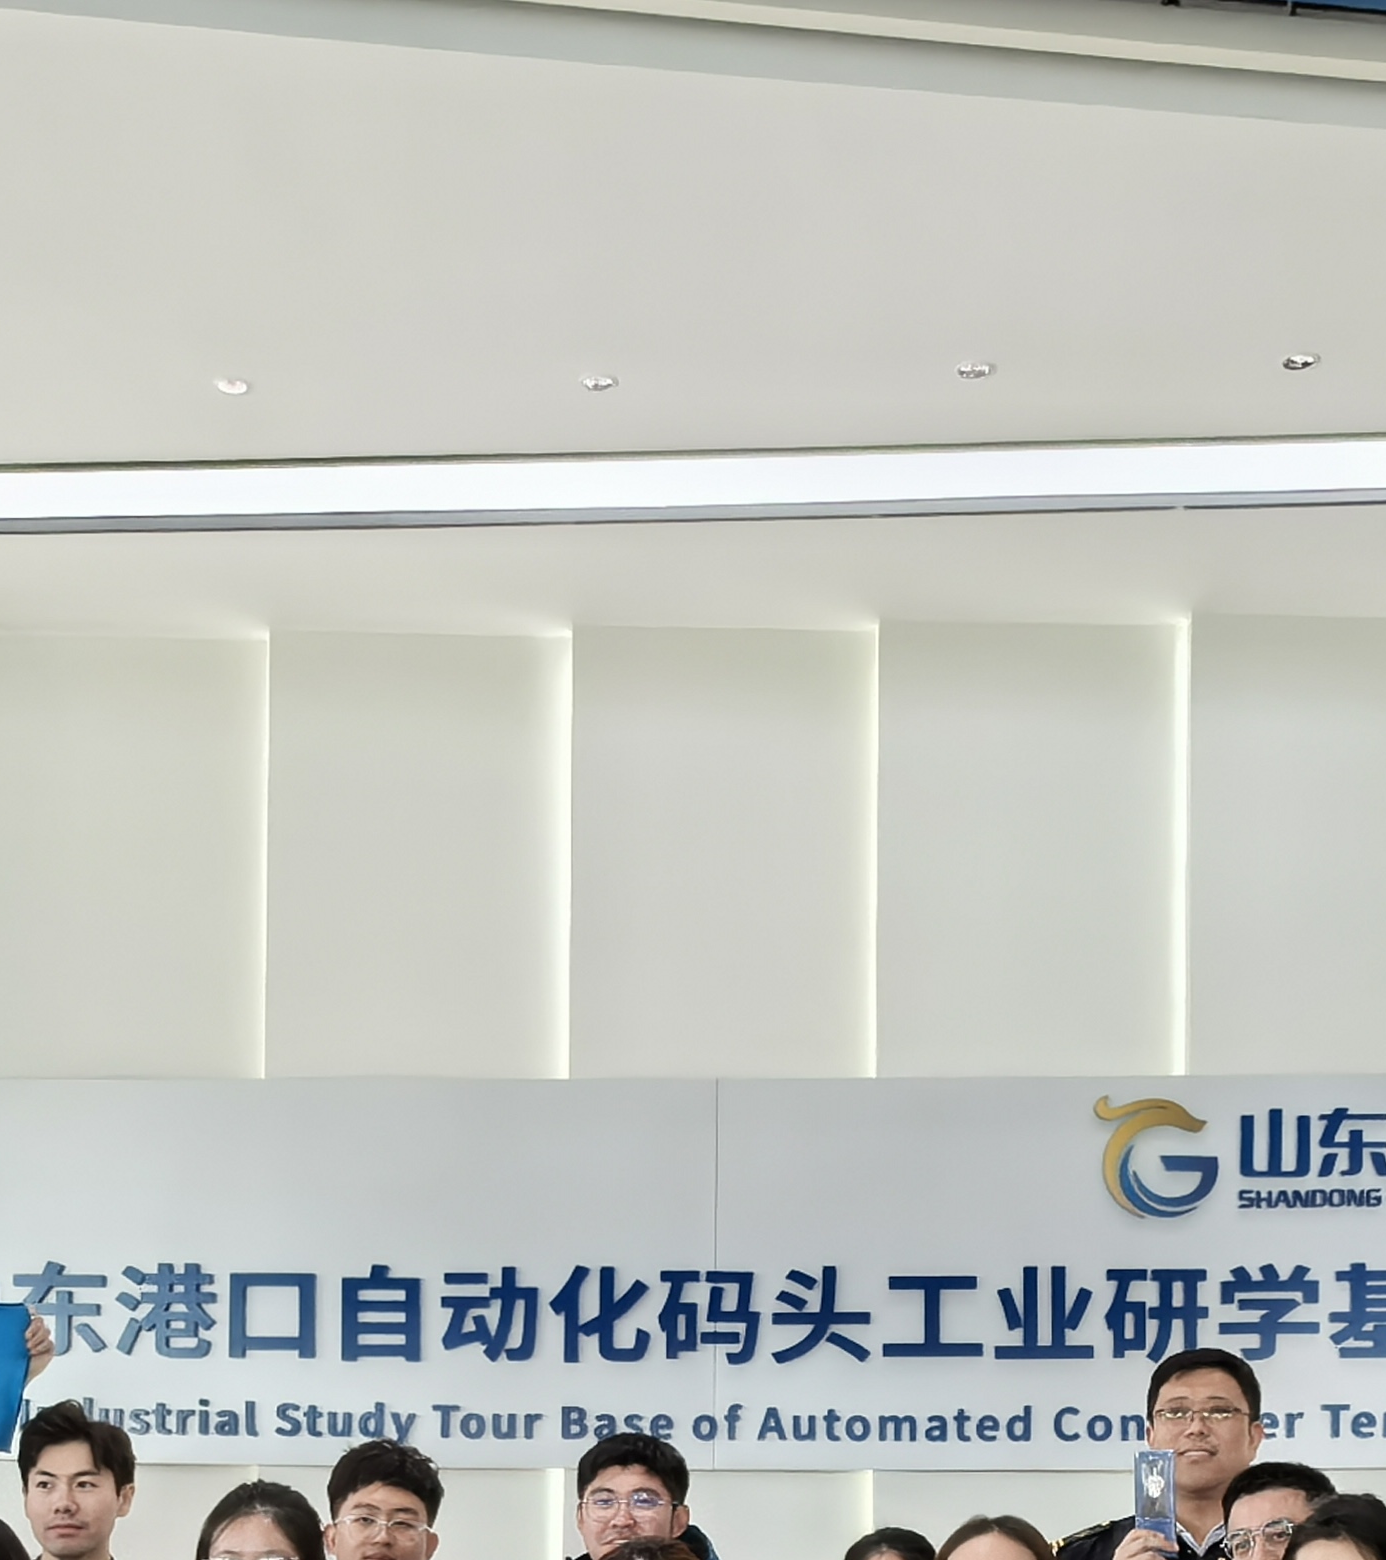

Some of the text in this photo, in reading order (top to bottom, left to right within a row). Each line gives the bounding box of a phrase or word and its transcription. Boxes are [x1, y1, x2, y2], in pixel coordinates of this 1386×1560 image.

[1237, 1187, 1383, 1209] SHANDONG
[274, 1401, 417, 1444] Study
[431, 1403, 545, 1441] Tour
[559, 1405, 675, 1442] Base
[691, 1402, 744, 1442] of
[757, 1402, 1033, 1443] Automated
[1052, 1404, 1304, 1442] Coner
